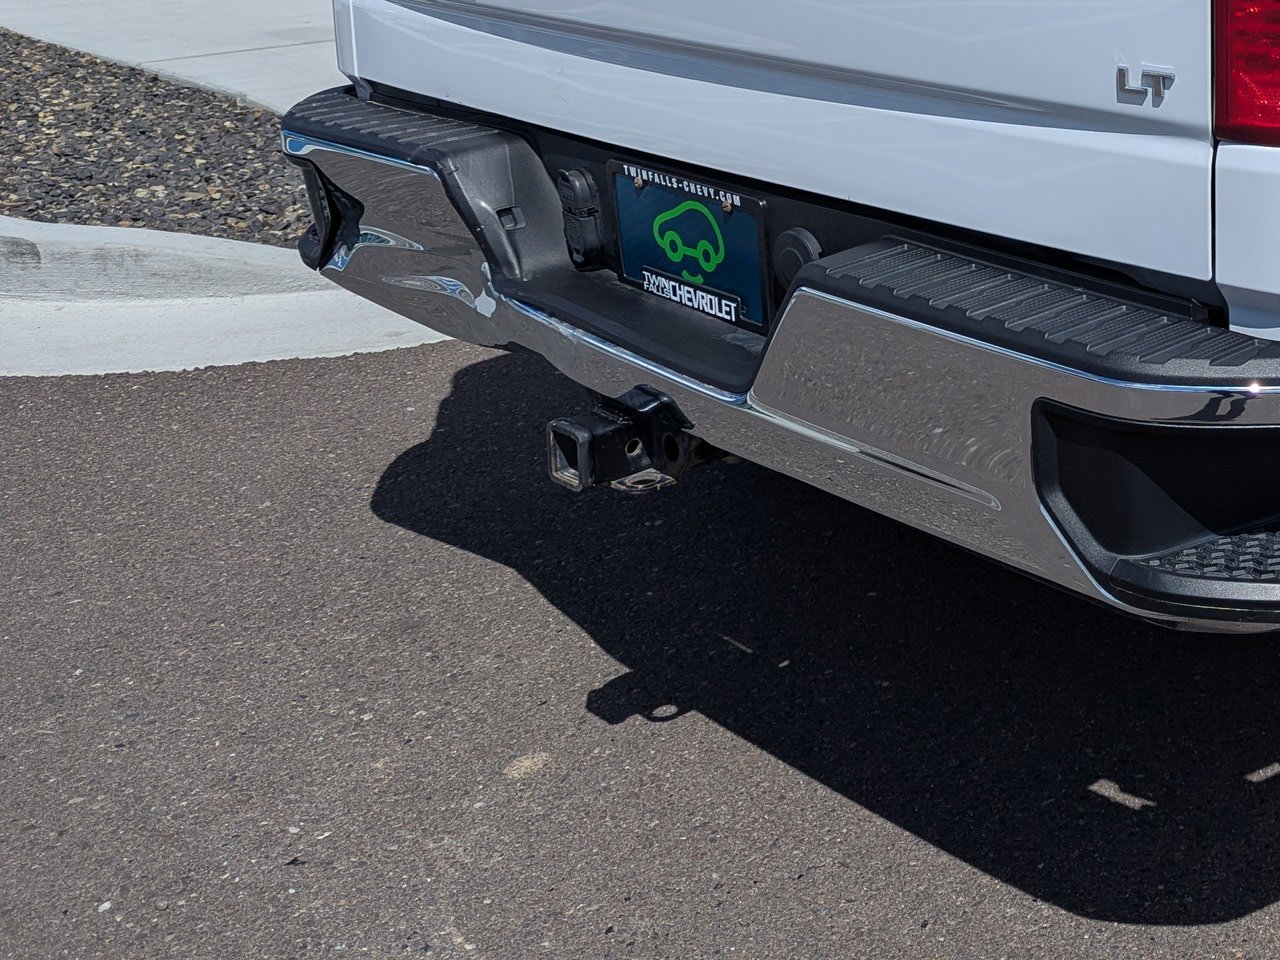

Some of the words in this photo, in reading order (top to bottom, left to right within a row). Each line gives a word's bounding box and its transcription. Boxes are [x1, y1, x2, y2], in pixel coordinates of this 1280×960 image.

[1116, 65, 1175, 103] LT
[622, 164, 741, 207] TWINFALLS-CHEVY.COM
[642, 271, 669, 289] TWIN
[643, 281, 670, 299] FALLS
[669, 281, 737, 322] CHEVROLET
